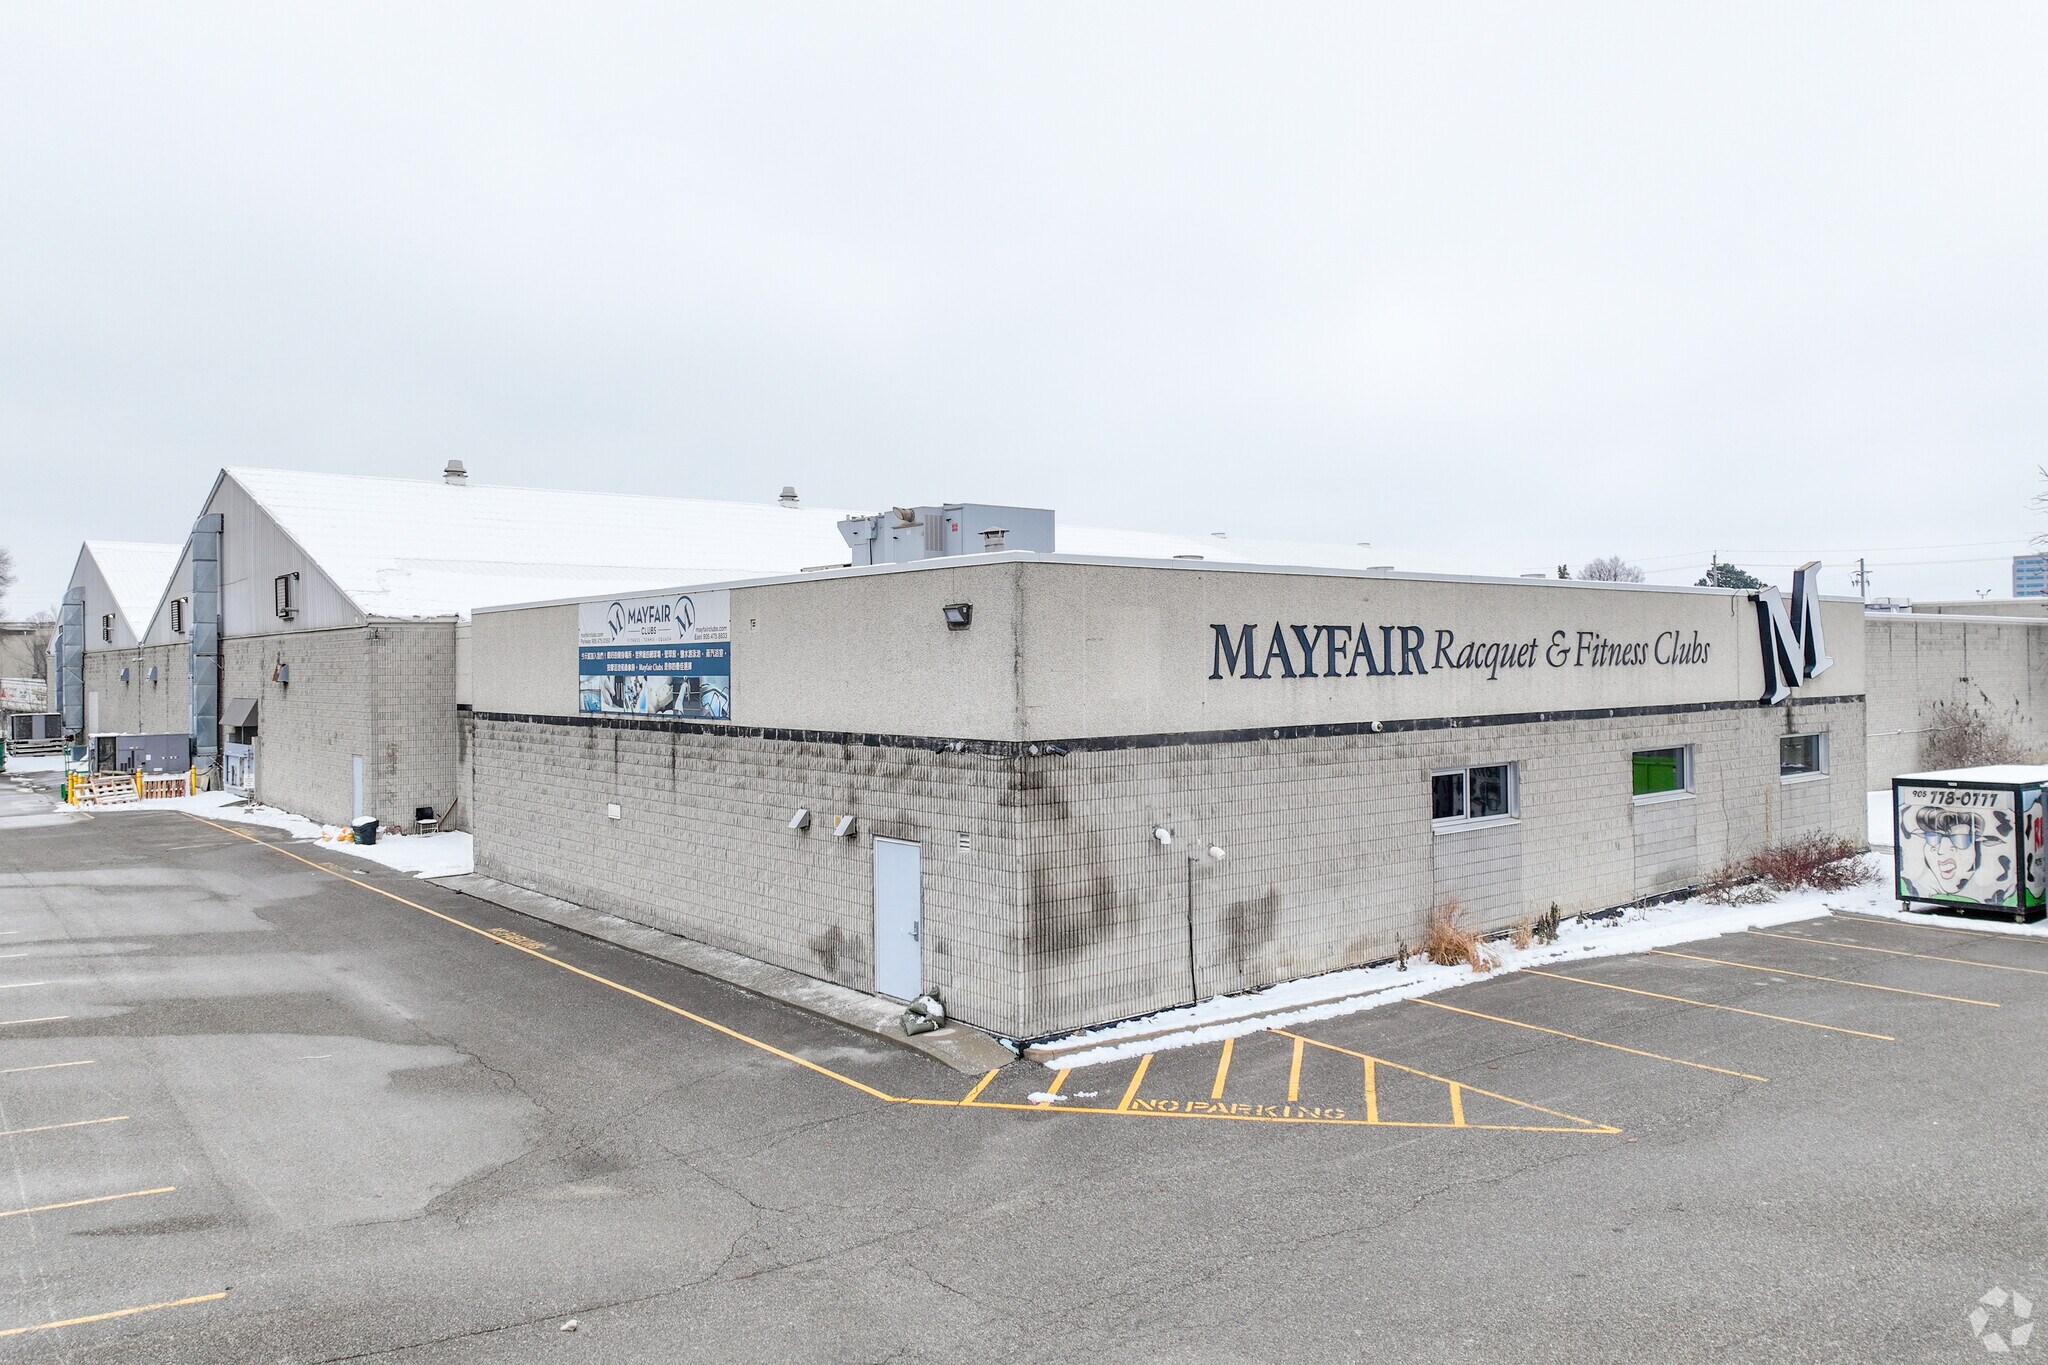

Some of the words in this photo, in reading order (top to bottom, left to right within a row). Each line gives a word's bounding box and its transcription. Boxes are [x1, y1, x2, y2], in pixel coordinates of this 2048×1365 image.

[628, 604, 671, 624] MAYFAIR
[641, 626, 657, 635] CLUBS
[1208, 622, 1429, 681] MAYFAIR
[1431, 629, 1538, 682] Racquet
[1545, 629, 1572, 668] &
[1574, 631, 1650, 668] Fitness
[1654, 631, 1711, 666] Clubs
[1912, 790, 1927, 798] 905
[1930, 791, 1998, 807] 778-0777
[1131, 1098, 1179, 1113] NO
[1185, 1100, 1346, 1119] PARKING
